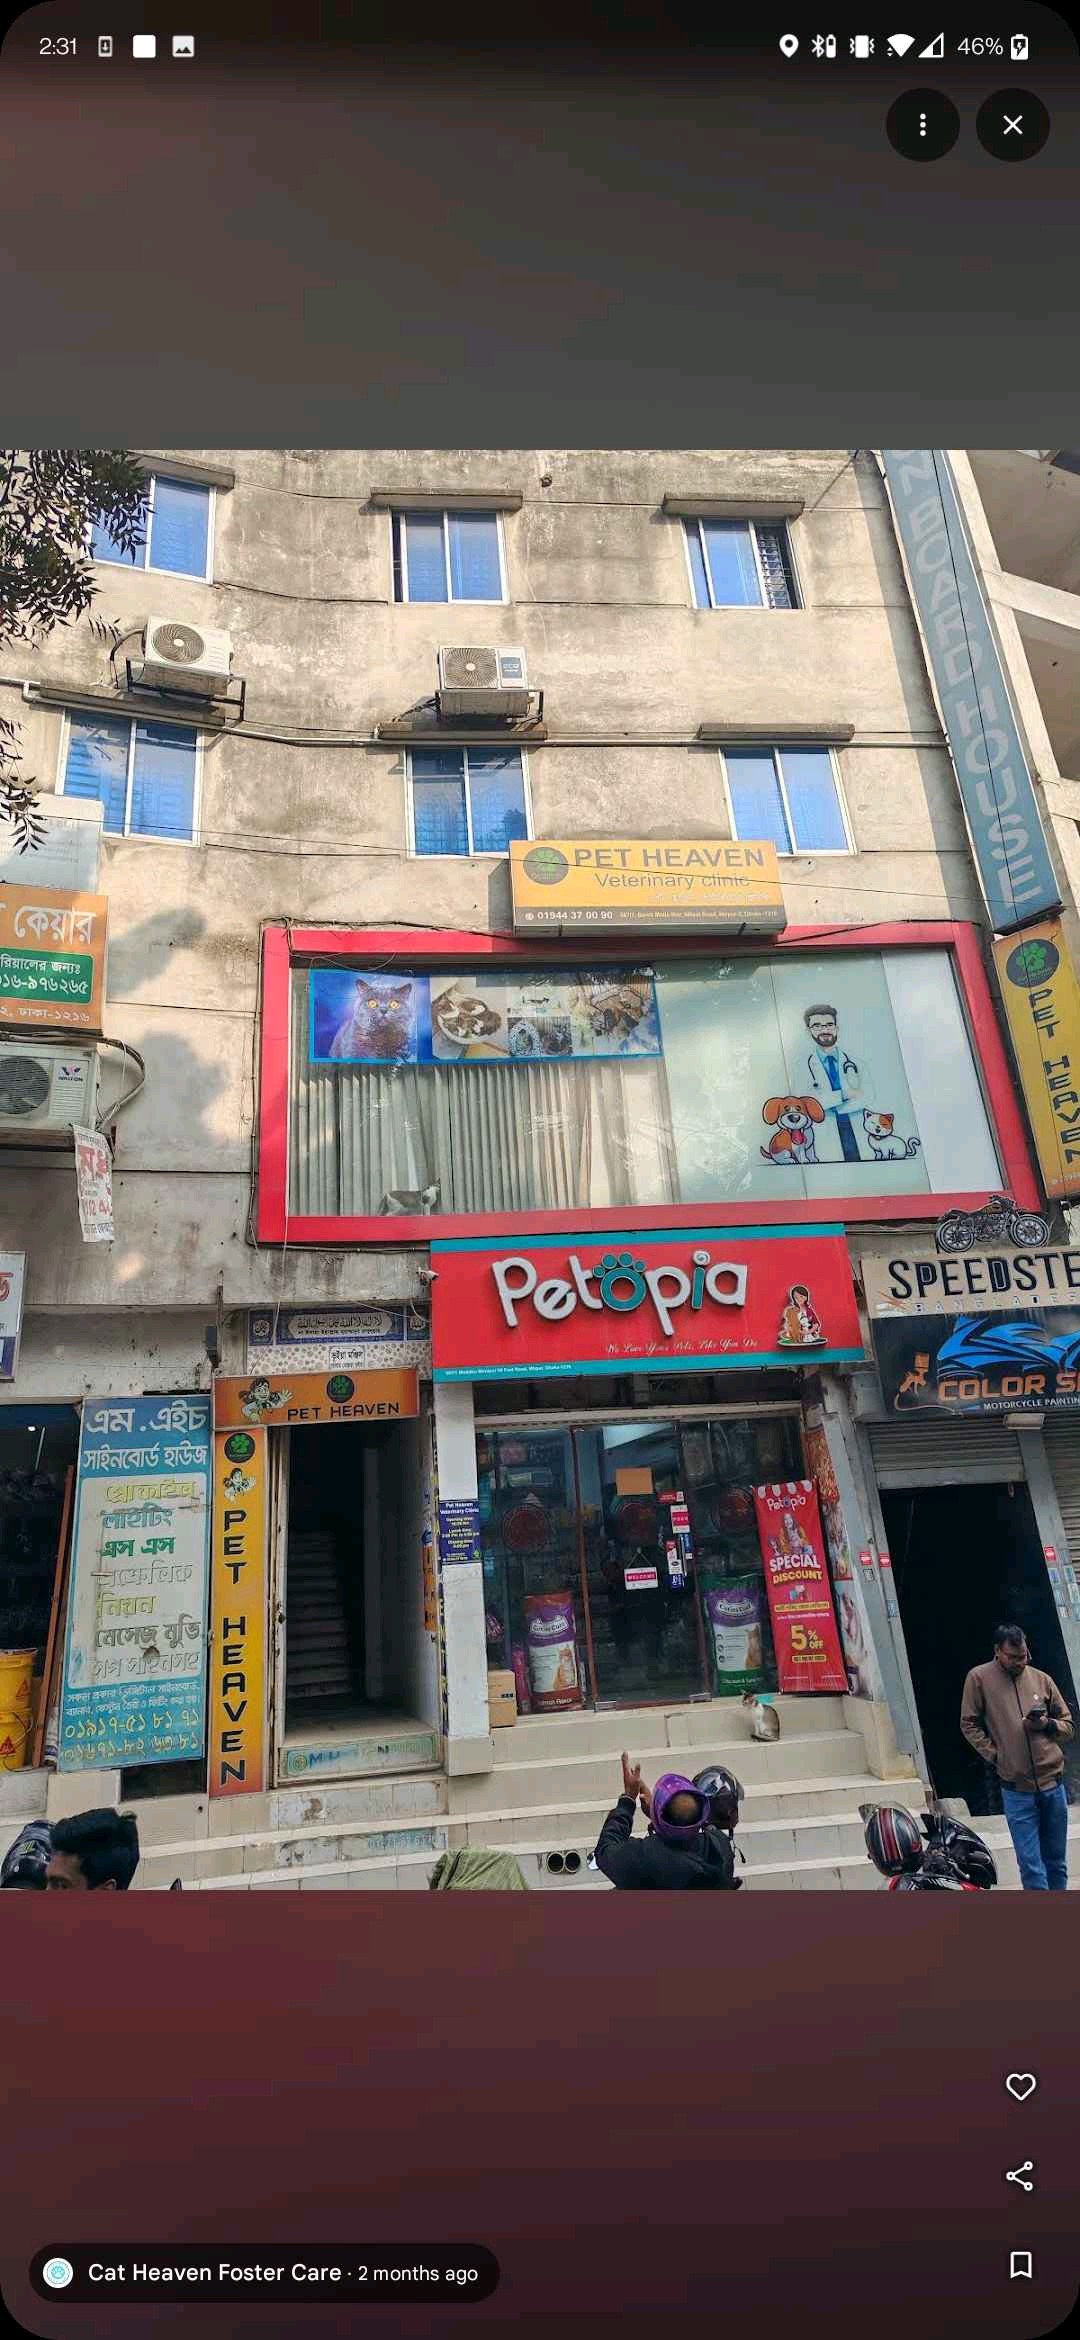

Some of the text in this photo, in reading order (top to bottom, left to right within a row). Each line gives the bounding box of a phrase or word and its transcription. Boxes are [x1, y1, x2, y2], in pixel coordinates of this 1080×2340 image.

[908, 495, 984, 688] BOARD
[956, 691, 1042, 910] HOUSE
[574, 847, 764, 868] PET HEAVEN
[594, 870, 750, 890] Veterinary clinic
[1029, 988, 1062, 1038] PET
[492, 1251, 749, 1336] Petopia
[938, 1373, 1047, 1401] COLOR
[287, 1401, 401, 1422] PET HEAVEN
[983, 1398, 1043, 1411] MOTORCYCLE
[163, 1440, 209, 1468] হাউজ
[140, 1537, 177, 1556] এস
[769, 1553, 822, 1574] SPECIAL
[772, 1569, 825, 1585] DISCOUNT
[219, 1509, 248, 1787] PET HEAVEN
[791, 1624, 807, 1651] 5
